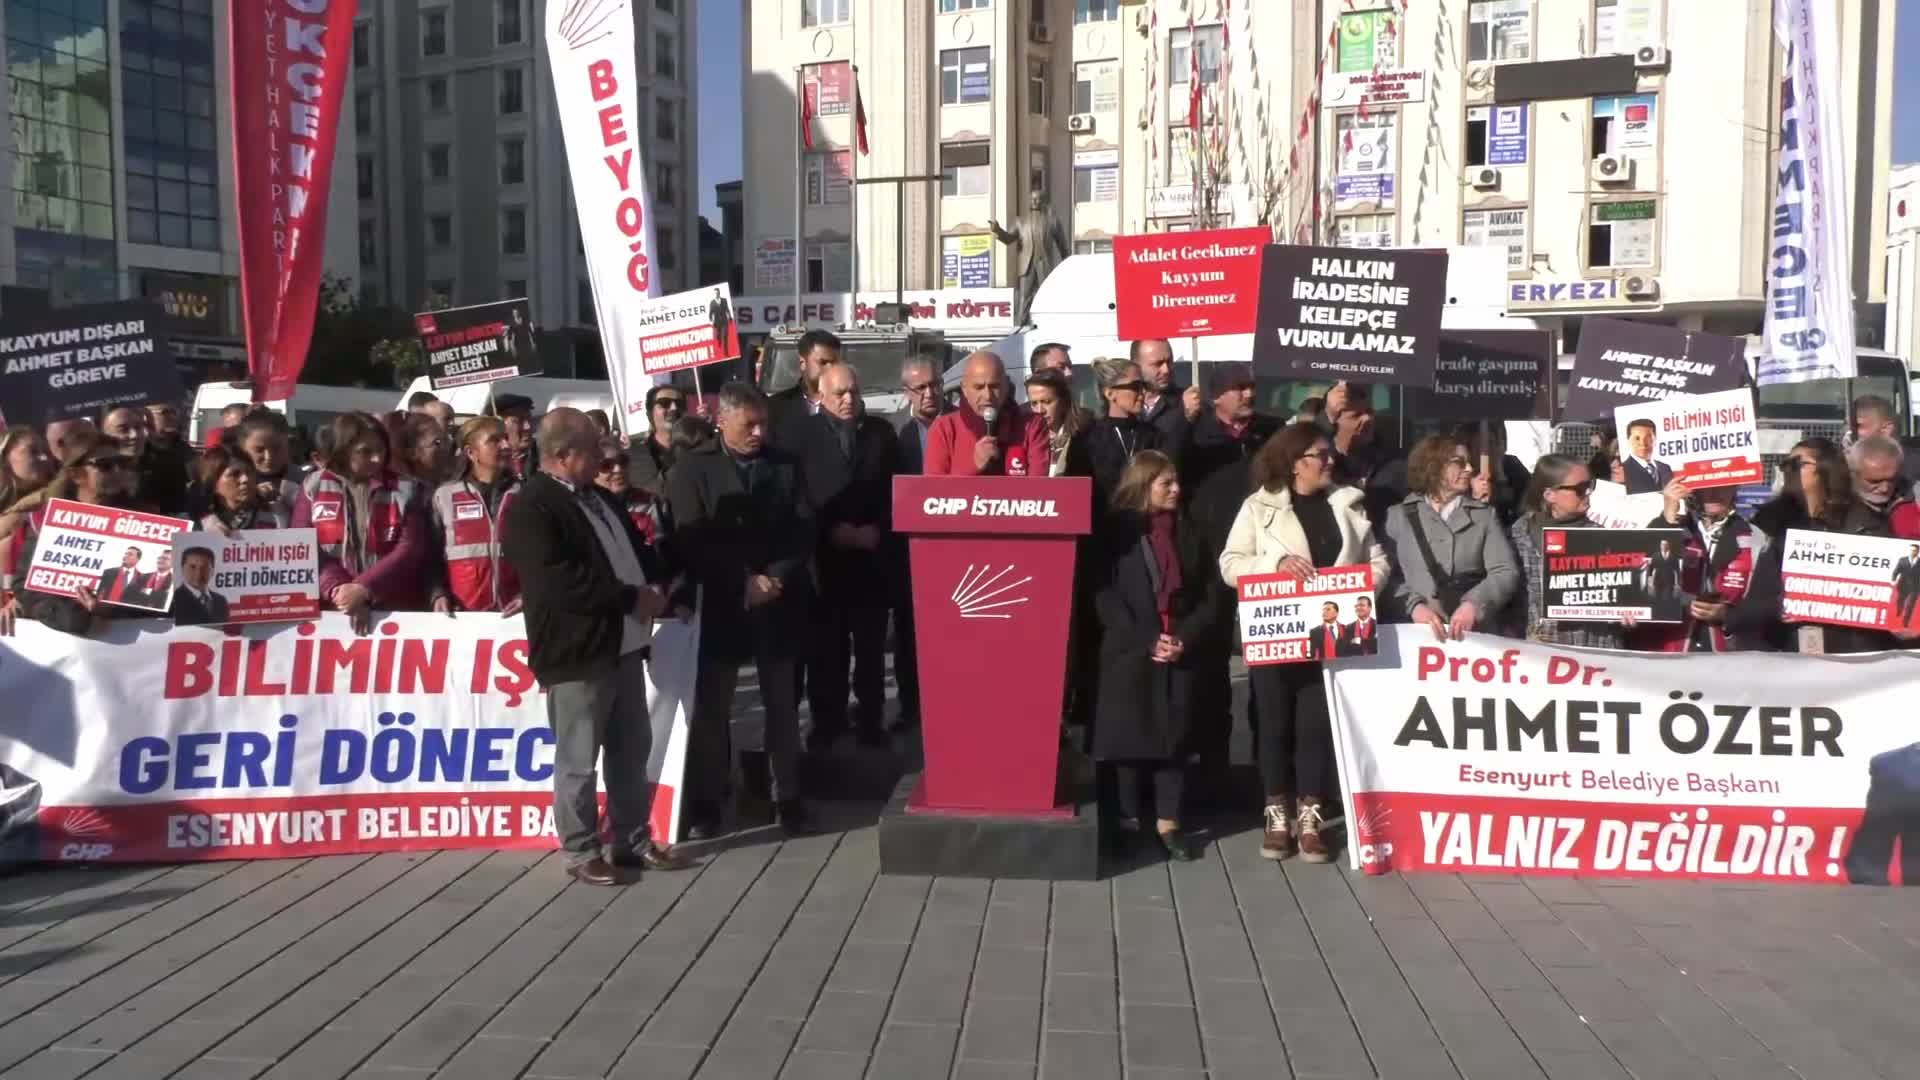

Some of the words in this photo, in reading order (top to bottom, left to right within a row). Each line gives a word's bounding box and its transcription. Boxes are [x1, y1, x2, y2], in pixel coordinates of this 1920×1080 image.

[1489, 211, 1524, 225] AVUKAT
[1128, 245, 1178, 264] Adalet
[1181, 242, 1257, 260] Gecikmez
[1161, 269, 1225, 287] Kayyum
[1311, 257, 1395, 281] HALKIN
[1152, 291, 1237, 309] Direnemez
[1292, 277, 1410, 306] İRADESİNE
[640, 312, 676, 326] AHMET
[764, 303, 835, 325] CAFE
[946, 299, 1011, 319] KÖFTE
[1299, 305, 1397, 330] KELEPÇE
[0, 328, 81, 353] KAYYUM
[83, 319, 145, 340] DIŞARI
[1277, 328, 1416, 355] VURULAMAZ
[5, 350, 73, 374] AHMET
[77, 339, 154, 363] BAŞKAN
[461, 338, 498, 360] BAŞKAN
[443, 357, 484, 376] GELECEK
[1600, 349, 1653, 367] AHMET
[1653, 356, 1716, 377] BAŞKAN
[48, 363, 126, 388] GÖREVE
[1577, 376, 1639, 396] KAYYUM
[1620, 367, 1689, 388] SEÇİLMİŞ
[1664, 407, 1712, 431] BİLİMİN
[1716, 406, 1746, 430] IŞIĞI
[1659, 434, 1688, 456] GERİ
[1692, 431, 1753, 453] DÖNECEK
[923, 497, 968, 515] CHP
[970, 495, 1059, 517] İSTANBUL
[52, 508, 110, 531] KAYYUM
[54, 534, 105, 553] AHMET
[223, 542, 274, 563] BİLİMİN
[279, 541, 309, 565] IŞIĞI
[42, 550, 103, 570] BAŞKAN
[1789, 550, 1845, 565] AHMET
[1848, 552, 1891, 570] ÖZER
[215, 567, 247, 588] GERİ
[251, 565, 315, 586] DÖNECEK
[1244, 580, 1297, 599] KAYYUM
[1303, 572, 1366, 593] GİDECEK
[1549, 574, 1585, 590] AHMET
[1587, 571, 1632, 590] BAŞKAN
[1562, 590, 1610, 606] GELECEK
[1253, 603, 1302, 619] AHMET
[1248, 620, 1306, 638] BAŞKAN
[1245, 640, 1304, 662] GELECEK
[163, 621, 450, 699] BİLİMİN
[470, 636, 547, 708] IŞ
[1417, 647, 1529, 685] Prof.
[1546, 654, 1613, 688] Dr.
[1394, 695, 1642, 754] AHMET
[1660, 689, 1844, 758] ÖZER
[118, 714, 298, 795] GERİ
[319, 711, 555, 785] DÖNEC
[1458, 764, 1571, 789] Esenyurt
[1581, 769, 1680, 793] Belediye
[1687, 772, 1781, 798] Başkanı
[167, 808, 348, 848] ESENYURT
[359, 796, 512, 839] BELEDİYE
[60, 843, 112, 860] CHP
[1419, 809, 1585, 870] YALNIZ
[1594, 807, 1816, 877] DEĞİLDİR
